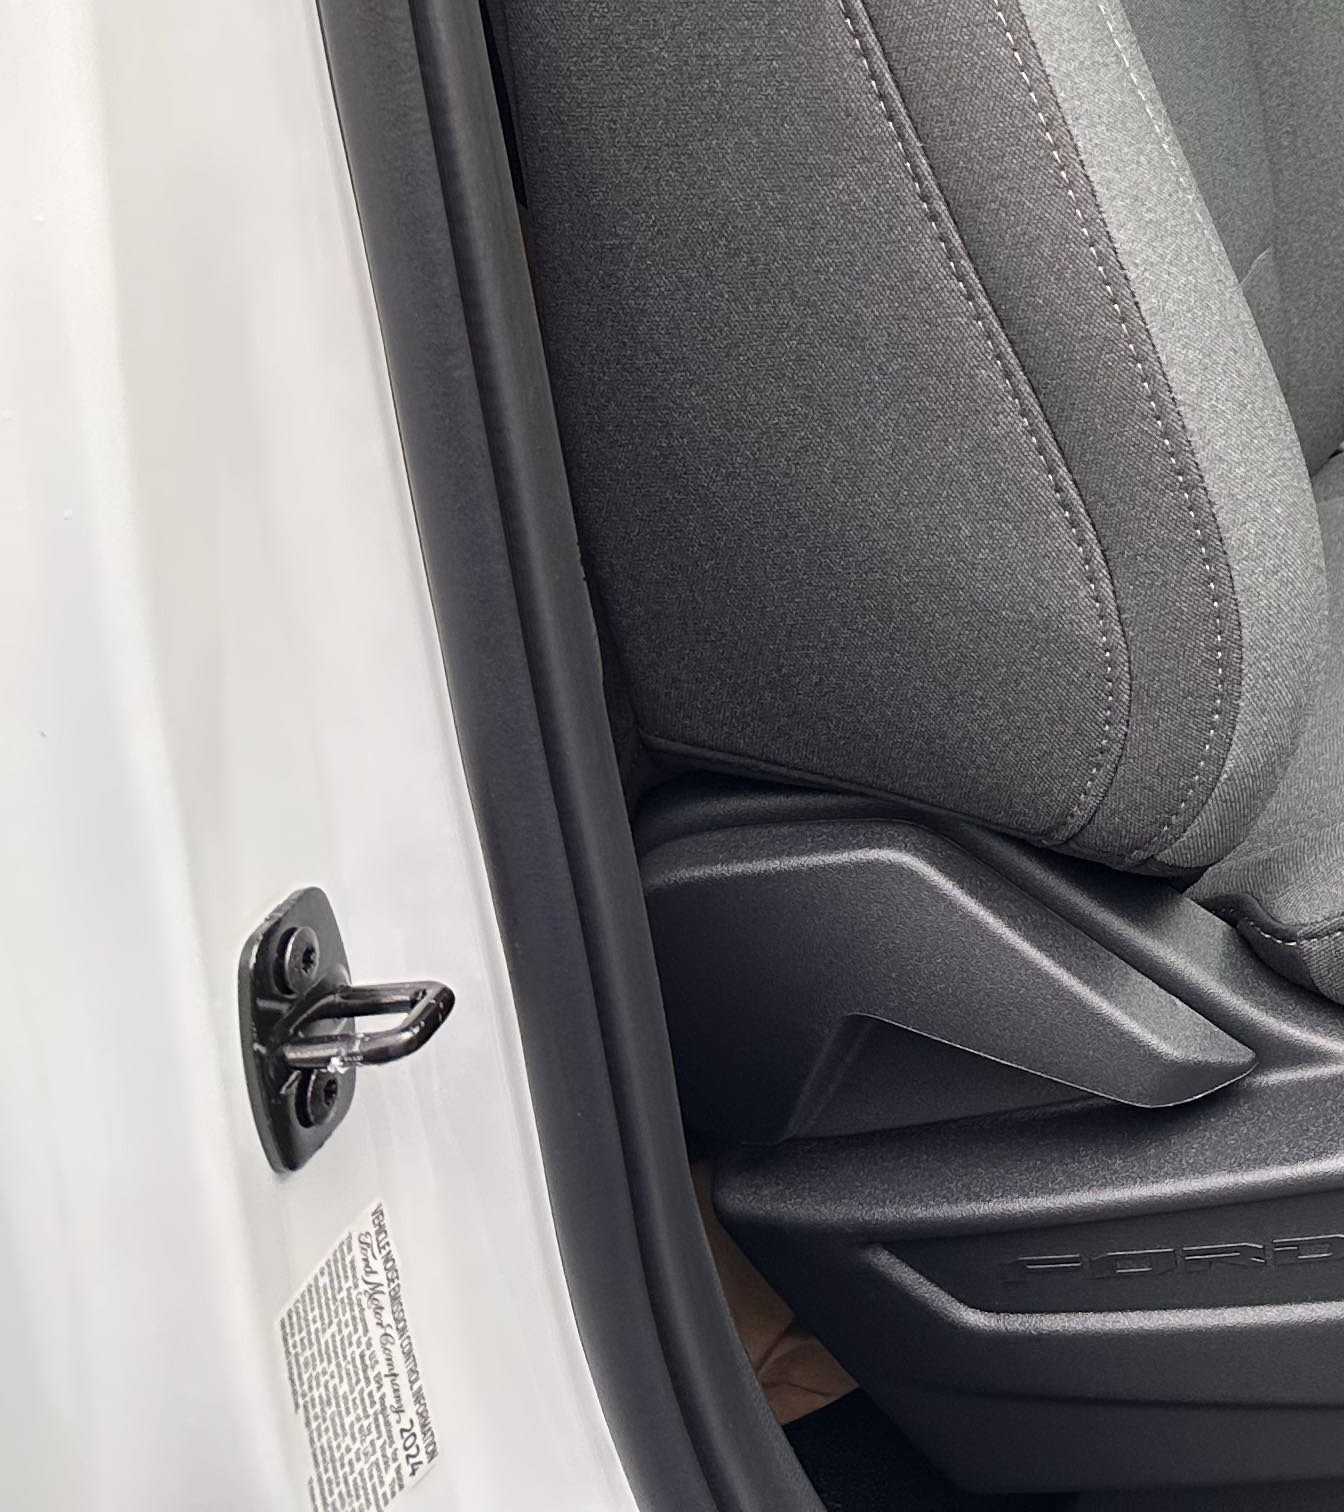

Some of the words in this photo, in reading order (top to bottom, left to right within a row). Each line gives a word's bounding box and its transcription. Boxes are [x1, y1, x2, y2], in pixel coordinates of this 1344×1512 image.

[371, 1202, 390, 1254] VEHICLE
[381, 1250, 399, 1288] NOISE
[389, 1283, 408, 1340] EMISSION
[358, 1231, 378, 1276] Ford
[400, 1418, 423, 1477] 2024
[400, 1335, 419, 1391] CONTROL
[412, 1384, 438, 1464] INFORMATION
